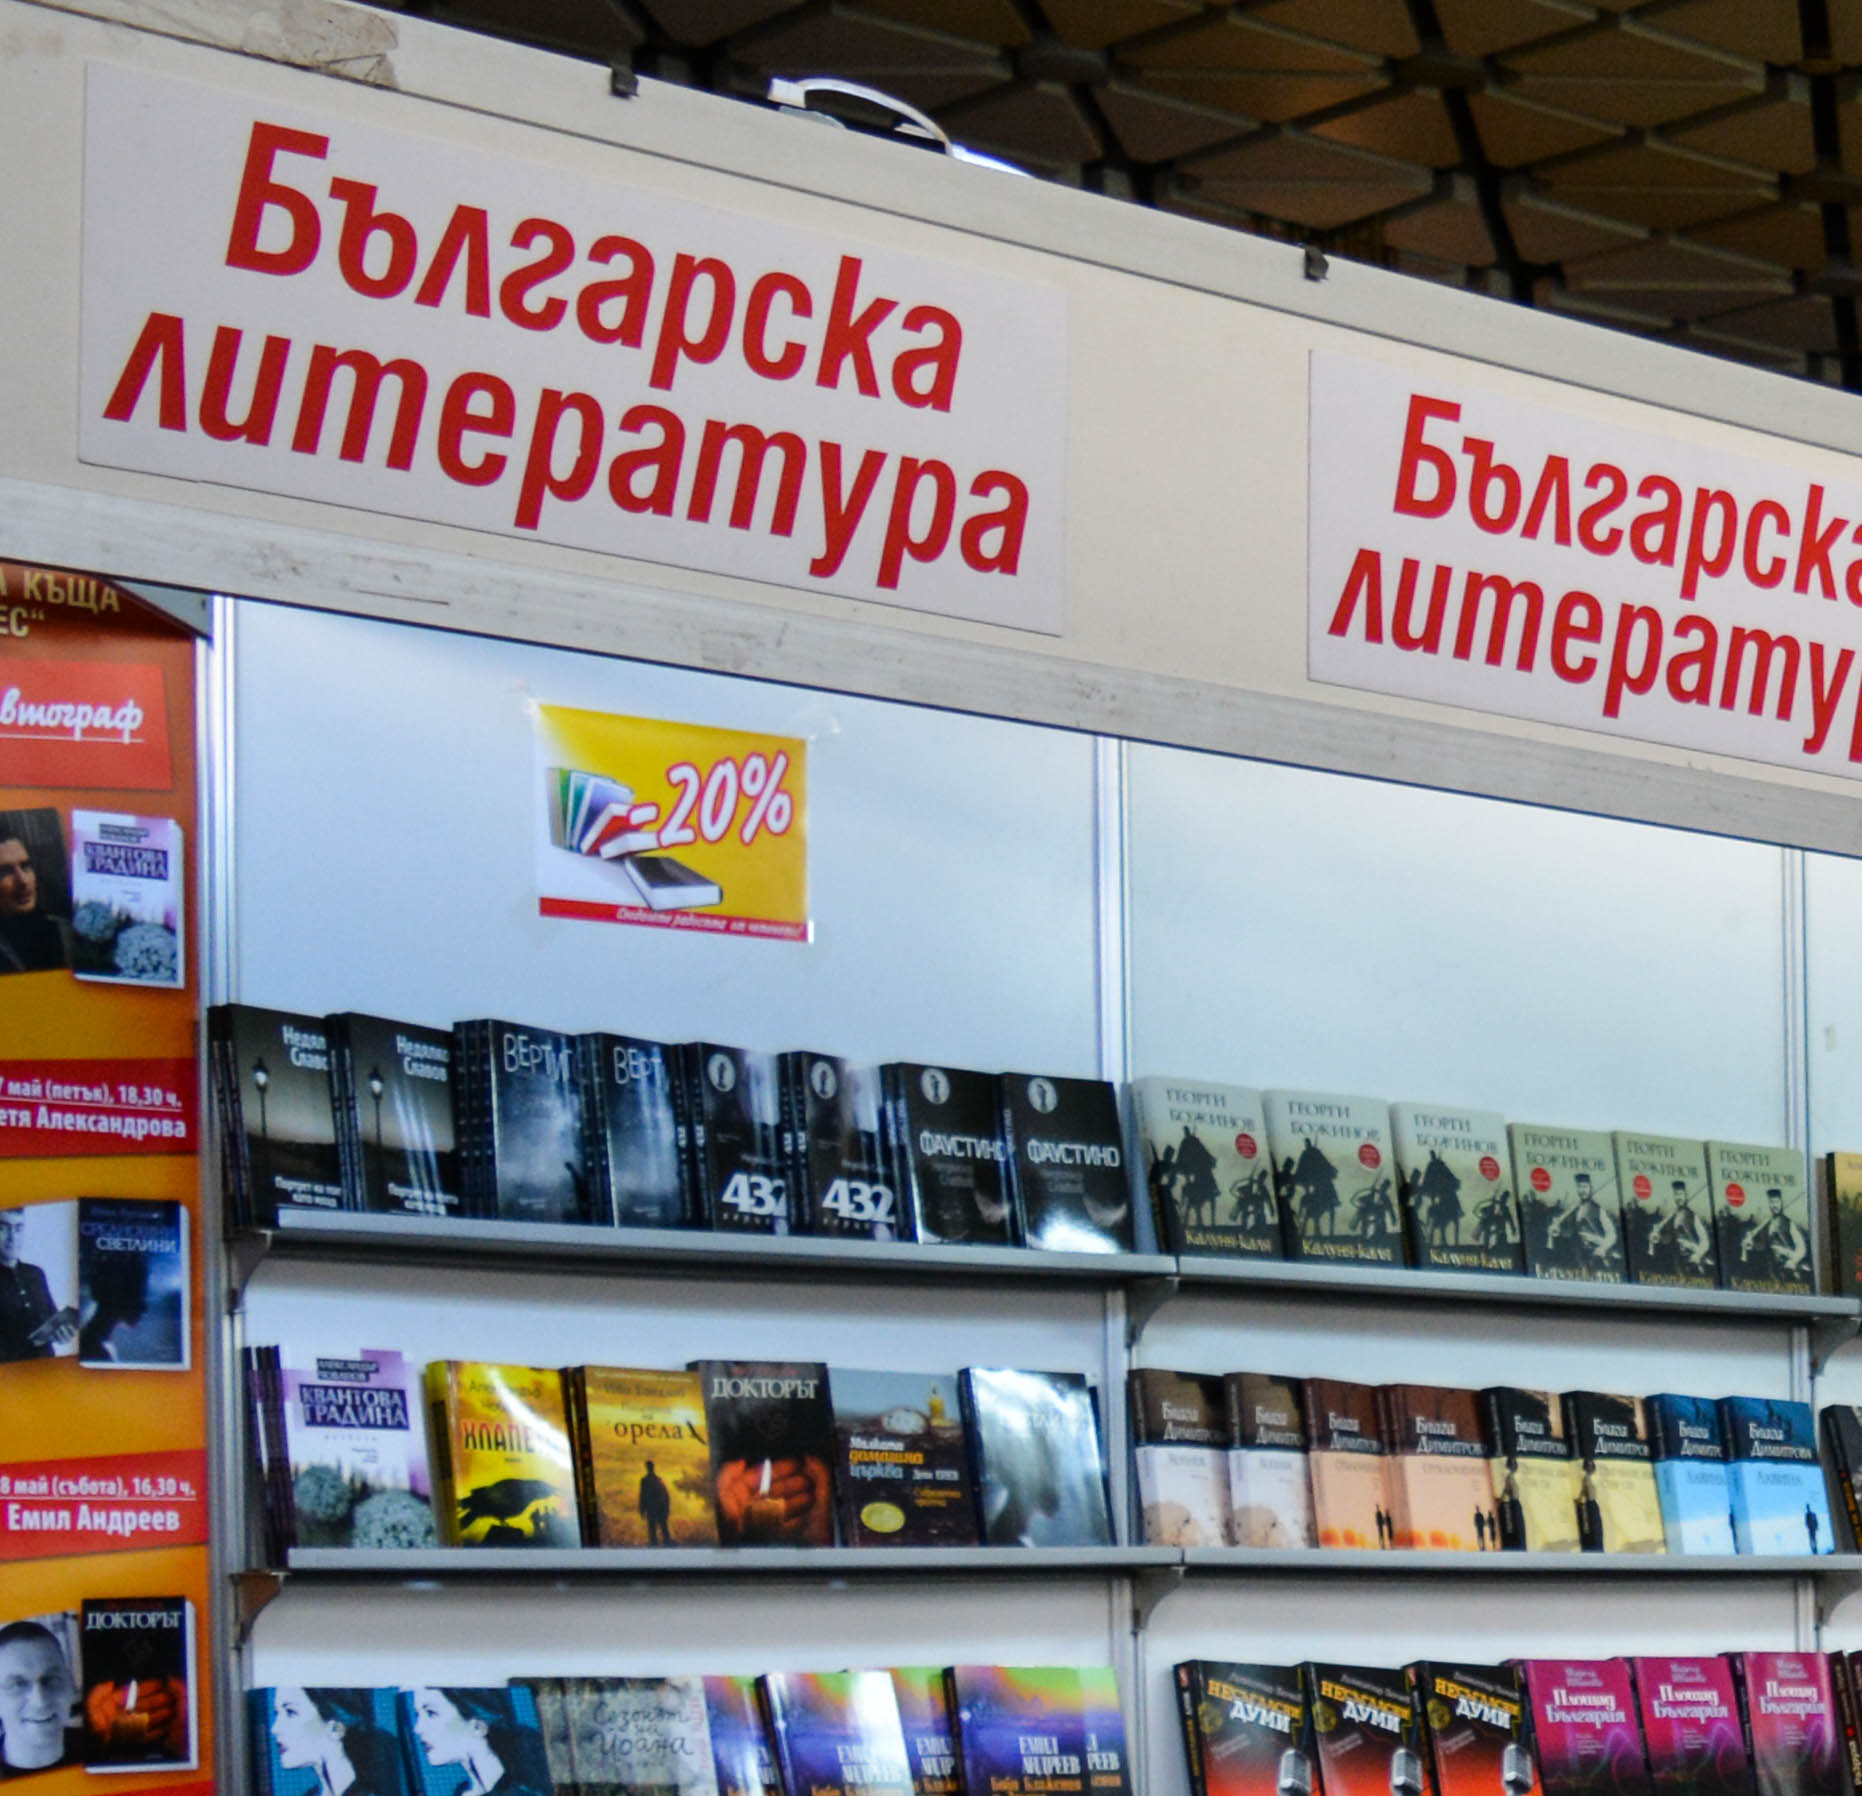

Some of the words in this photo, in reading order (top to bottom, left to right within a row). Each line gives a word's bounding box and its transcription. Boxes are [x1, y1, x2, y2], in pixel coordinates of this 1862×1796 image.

[225, 121, 964, 413] Българска
[103, 313, 1031, 589] литература
[23, 570, 120, 613] КЪЩА
[627, 750, 792, 848] -20%
[8, 1079, 42, 1099] май
[1166, 1088, 1226, 1108] ГЕОРГИ
[1288, 1100, 1350, 1119] ГЕОРГИ
[35, 1105, 187, 1139] Александрова
[1414, 1113, 1471, 1132] ГЕОРГИ
[1027, 1139, 1120, 1168] ФАУСТИНО
[1523, 1132, 1579, 1152] ГЕОРГИ
[1626, 1140, 1674, 1159] ГЕОРГИ
[1719, 1149, 1770, 1168] ГЕОРГИ
[823, 1179, 895, 1223] 432
[300, 1386, 406, 1410] КВАНТОВА
[711, 1377, 819, 1400] ДОКТОРЪТ
[305, 1404, 409, 1428] ГРАДИНА
[615, 1421, 683, 1446] орела
[15, 1476, 49, 1497] май
[8, 1504, 72, 1531] Емил
[77, 1504, 180, 1537] Андреев
[85, 1608, 183, 1632] ДОКТОРЪТ
[1230, 1700, 1291, 1734] ДУМИ
[1343, 1700, 1400, 1734] ДУМИ
[1456, 1696, 1510, 1730] ДУМИ
